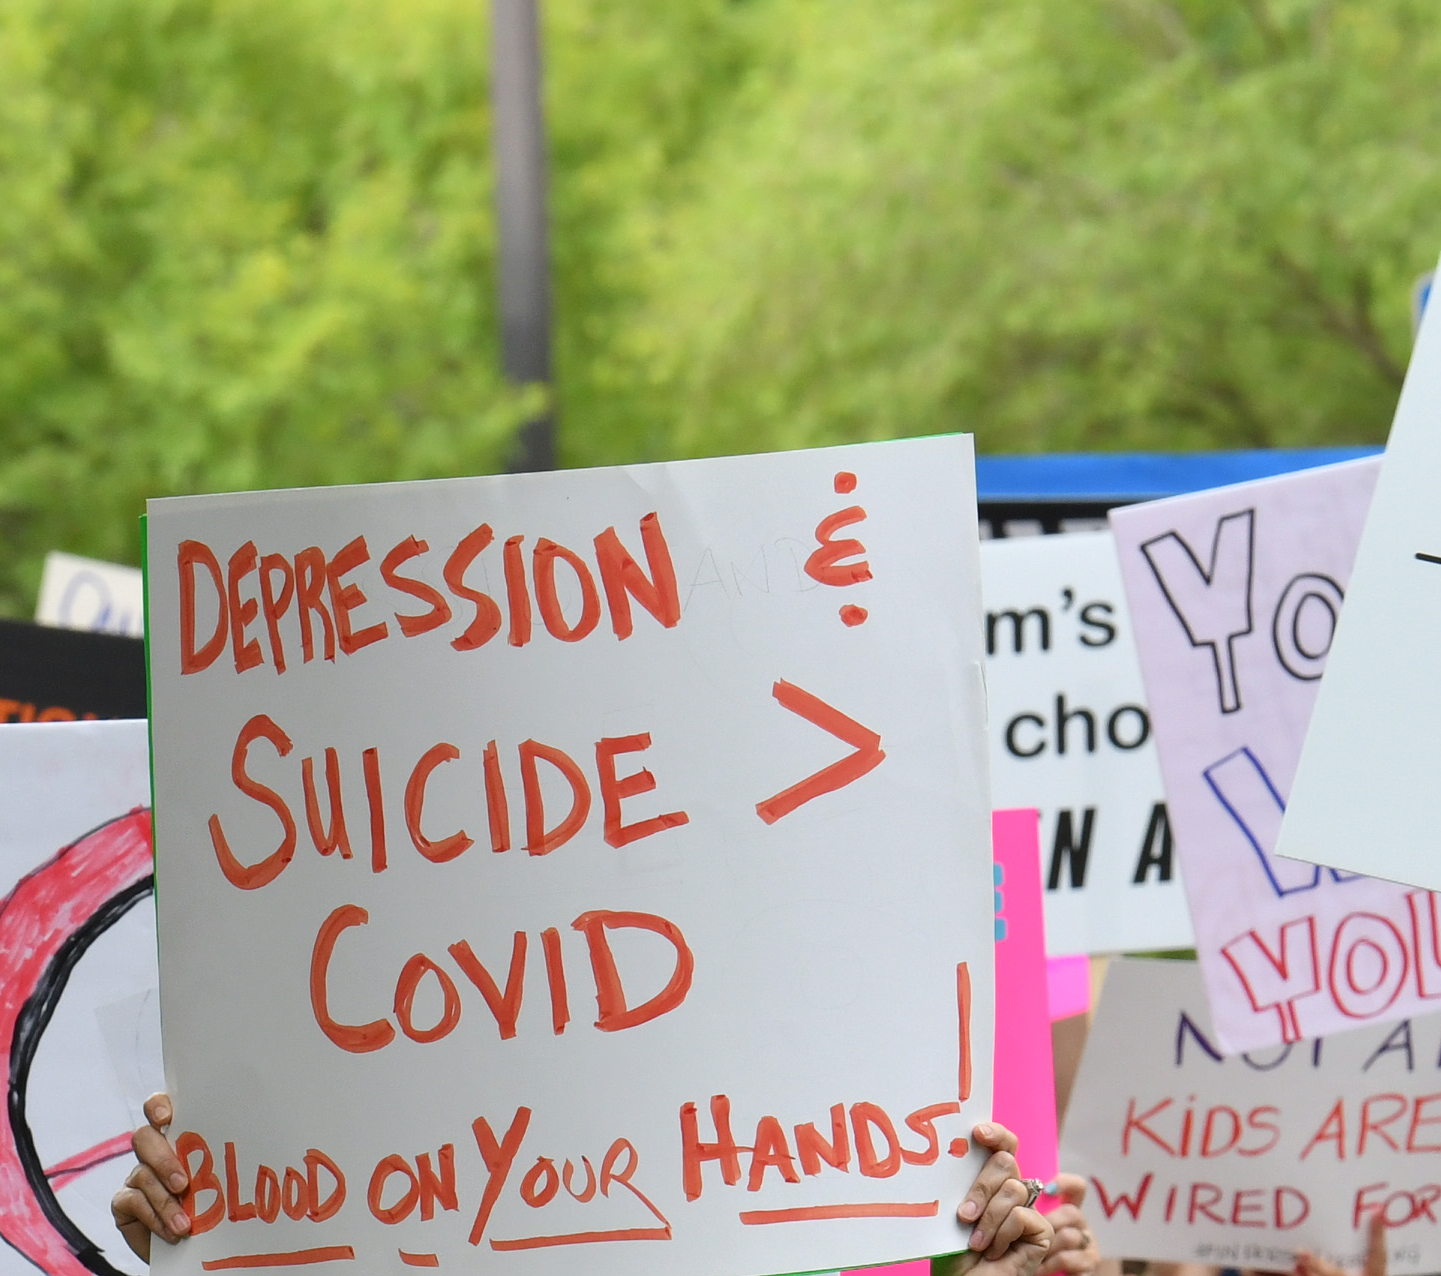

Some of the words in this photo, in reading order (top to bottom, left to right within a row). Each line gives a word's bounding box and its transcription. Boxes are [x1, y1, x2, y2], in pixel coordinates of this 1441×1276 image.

[178, 511, 681, 675] DEPRESSION
[209, 713, 689, 890] SUICIDE
[310, 904, 694, 1053] COVID
[175, 1130, 346, 1236] BLOOD
[368, 1143, 460, 1226] ON
[468, 1107, 669, 1246] YOUR
[1090, 1171, 1310, 1231] WIRED
